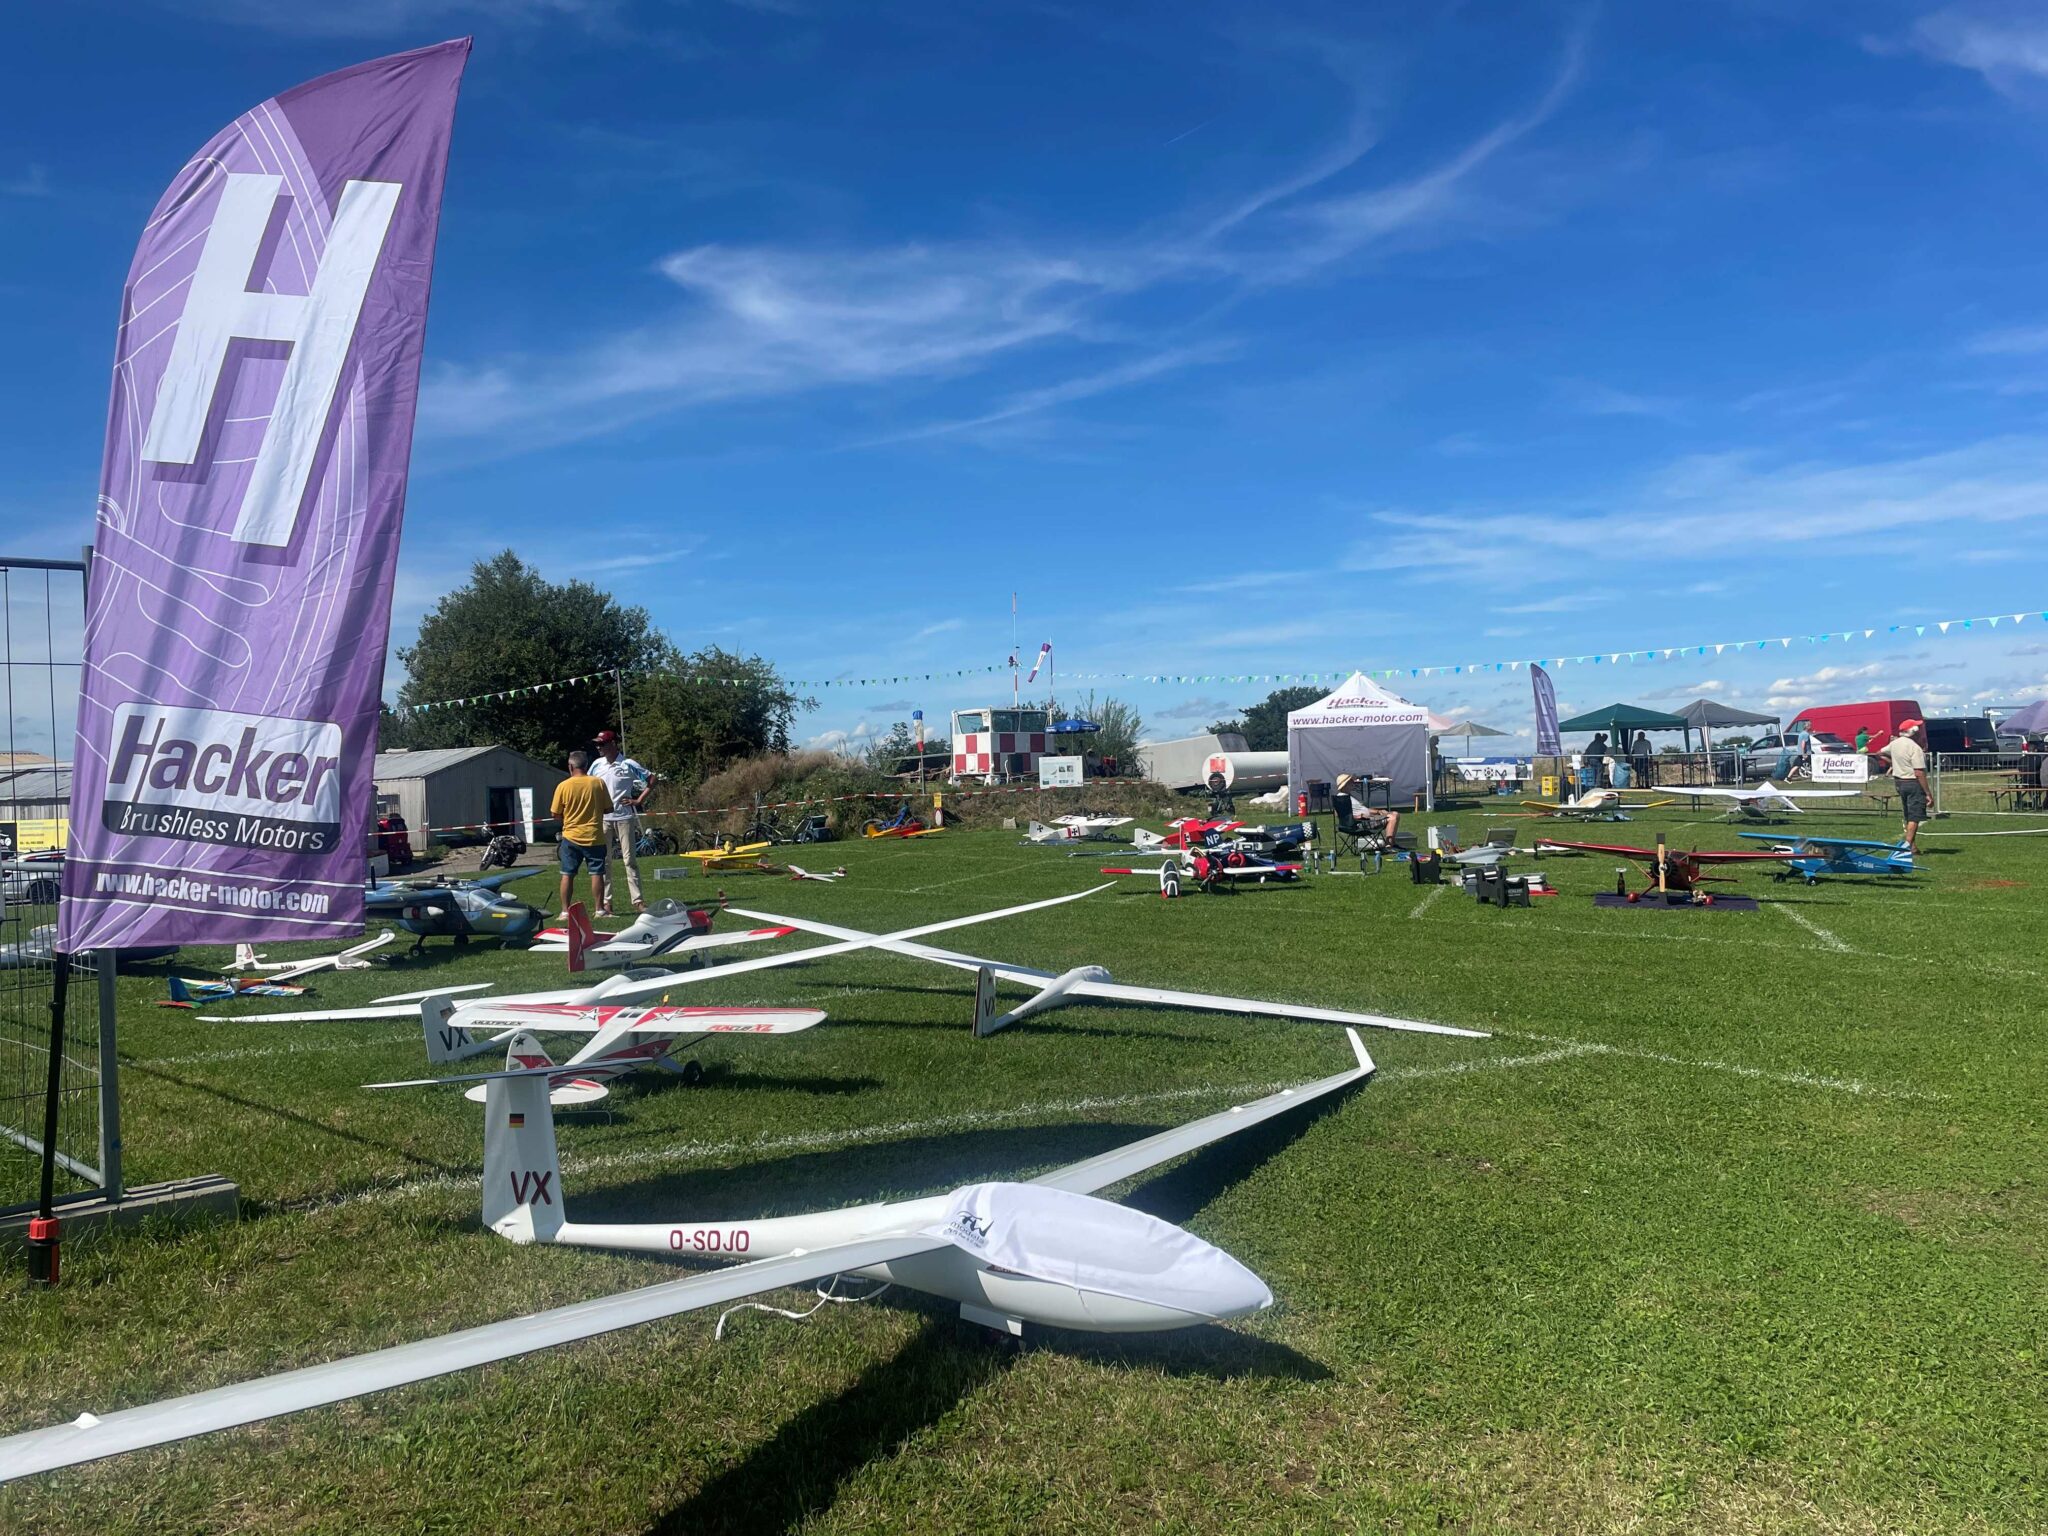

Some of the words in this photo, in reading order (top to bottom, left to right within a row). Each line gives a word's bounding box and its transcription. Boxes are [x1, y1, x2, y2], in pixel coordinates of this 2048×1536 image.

[141, 173, 403, 548] H
[1293, 713, 1423, 726] www.hacker-motor.com
[108, 715, 338, 806] Hacker
[1823, 757, 1855, 770] Hacker
[120, 805, 229, 840] Brushless
[234, 817, 325, 850] Motors
[1205, 833, 1220, 846] NP
[438, 1026, 469, 1052] VX
[510, 1170, 552, 1206] VX
